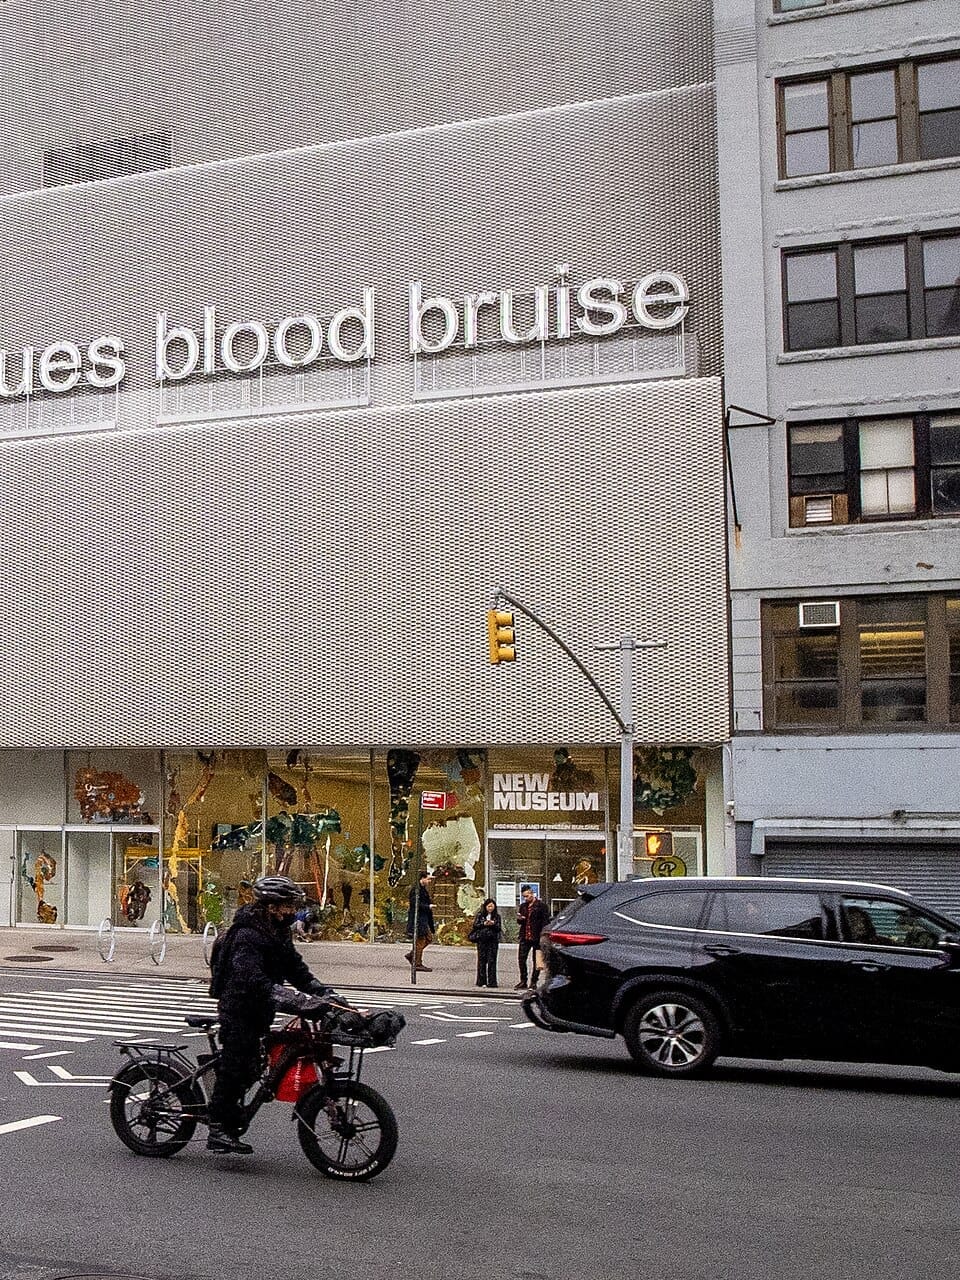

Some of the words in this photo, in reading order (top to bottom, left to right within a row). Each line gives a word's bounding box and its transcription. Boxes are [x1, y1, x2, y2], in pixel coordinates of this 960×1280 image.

[155, 287, 375, 380] blood
[409, 263, 689, 353] bruise
[493, 773, 550, 792] NEW
[493, 792, 599, 811] MUSEUM
